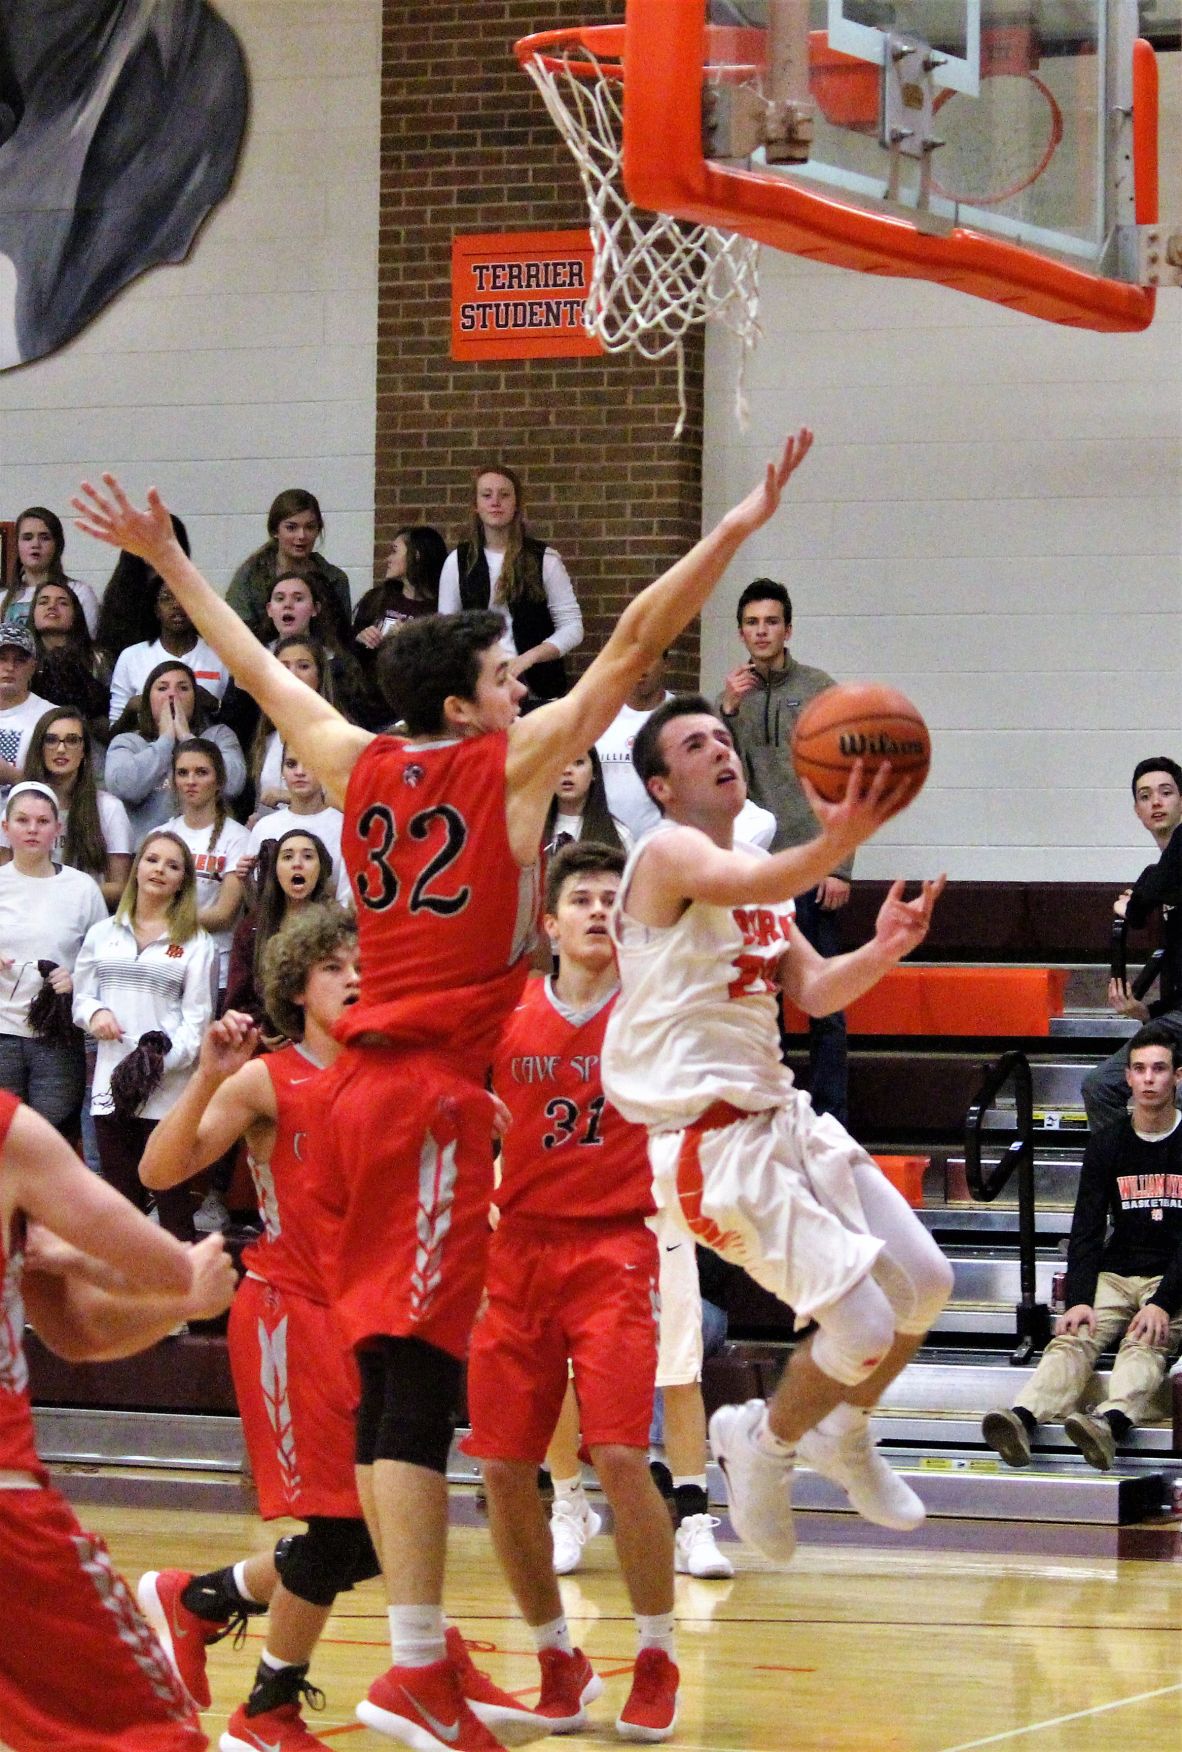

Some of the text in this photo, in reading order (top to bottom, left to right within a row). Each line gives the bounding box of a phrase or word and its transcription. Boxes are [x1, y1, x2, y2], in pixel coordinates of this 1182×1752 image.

[472, 261, 585, 291] TERRIER
[357, 802, 470, 917] 32
[511, 1055, 561, 1083] CAVE
[543, 1096, 605, 1148] 31
